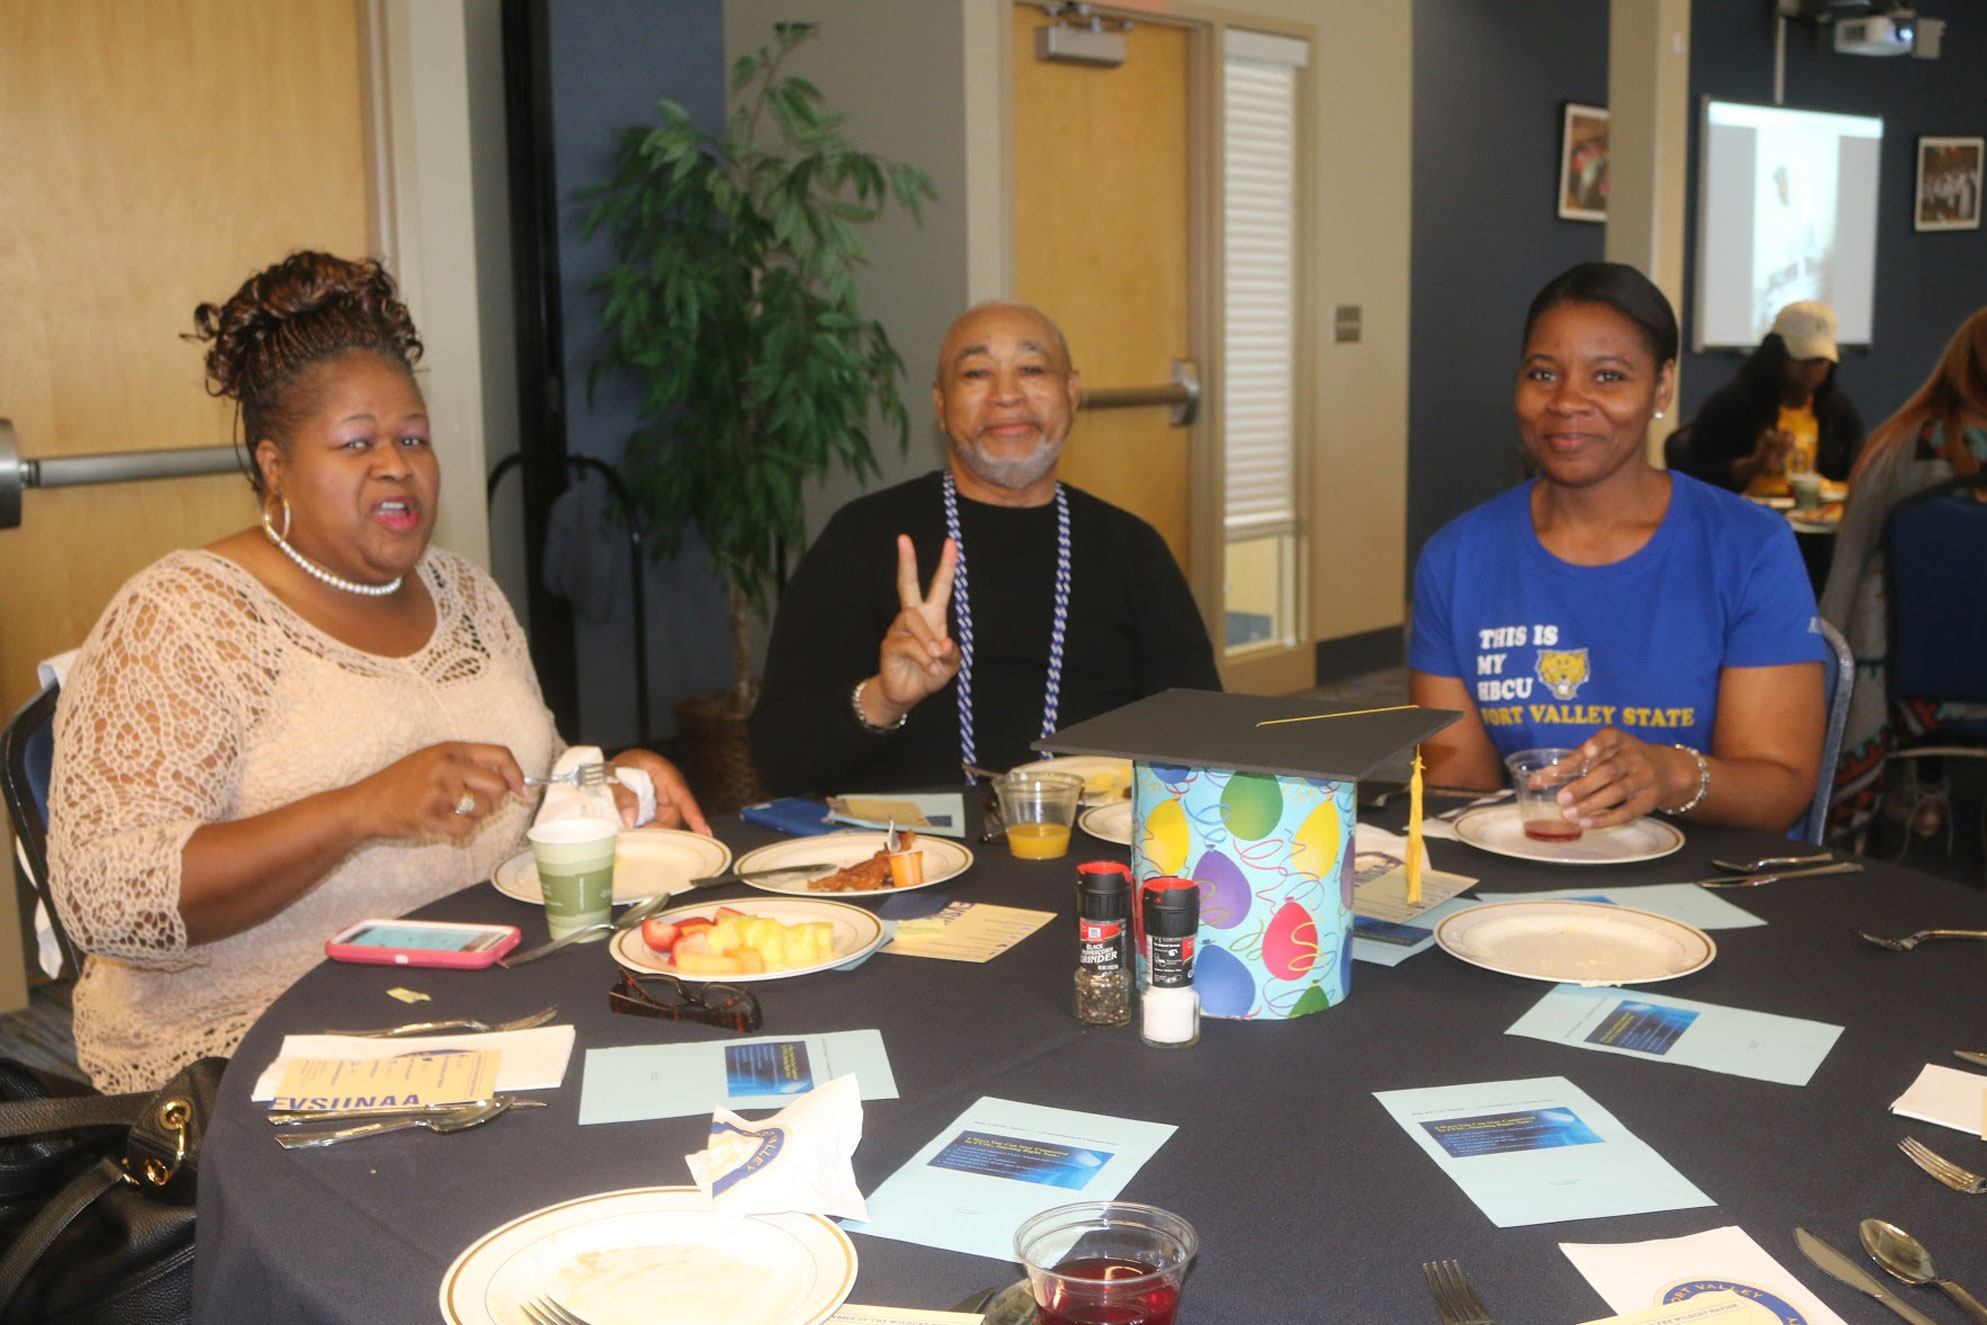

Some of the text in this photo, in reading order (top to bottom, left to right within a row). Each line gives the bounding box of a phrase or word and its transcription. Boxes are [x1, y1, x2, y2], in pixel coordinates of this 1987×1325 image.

[1479, 625, 1558, 649] THIS IS
[1477, 653, 1507, 675] MY
[1477, 677, 1534, 702] HBCU
[1529, 704, 1616, 724] VALLEY
[1622, 707, 1695, 727] STATE
[1671, 1286, 1691, 1303] ORT
